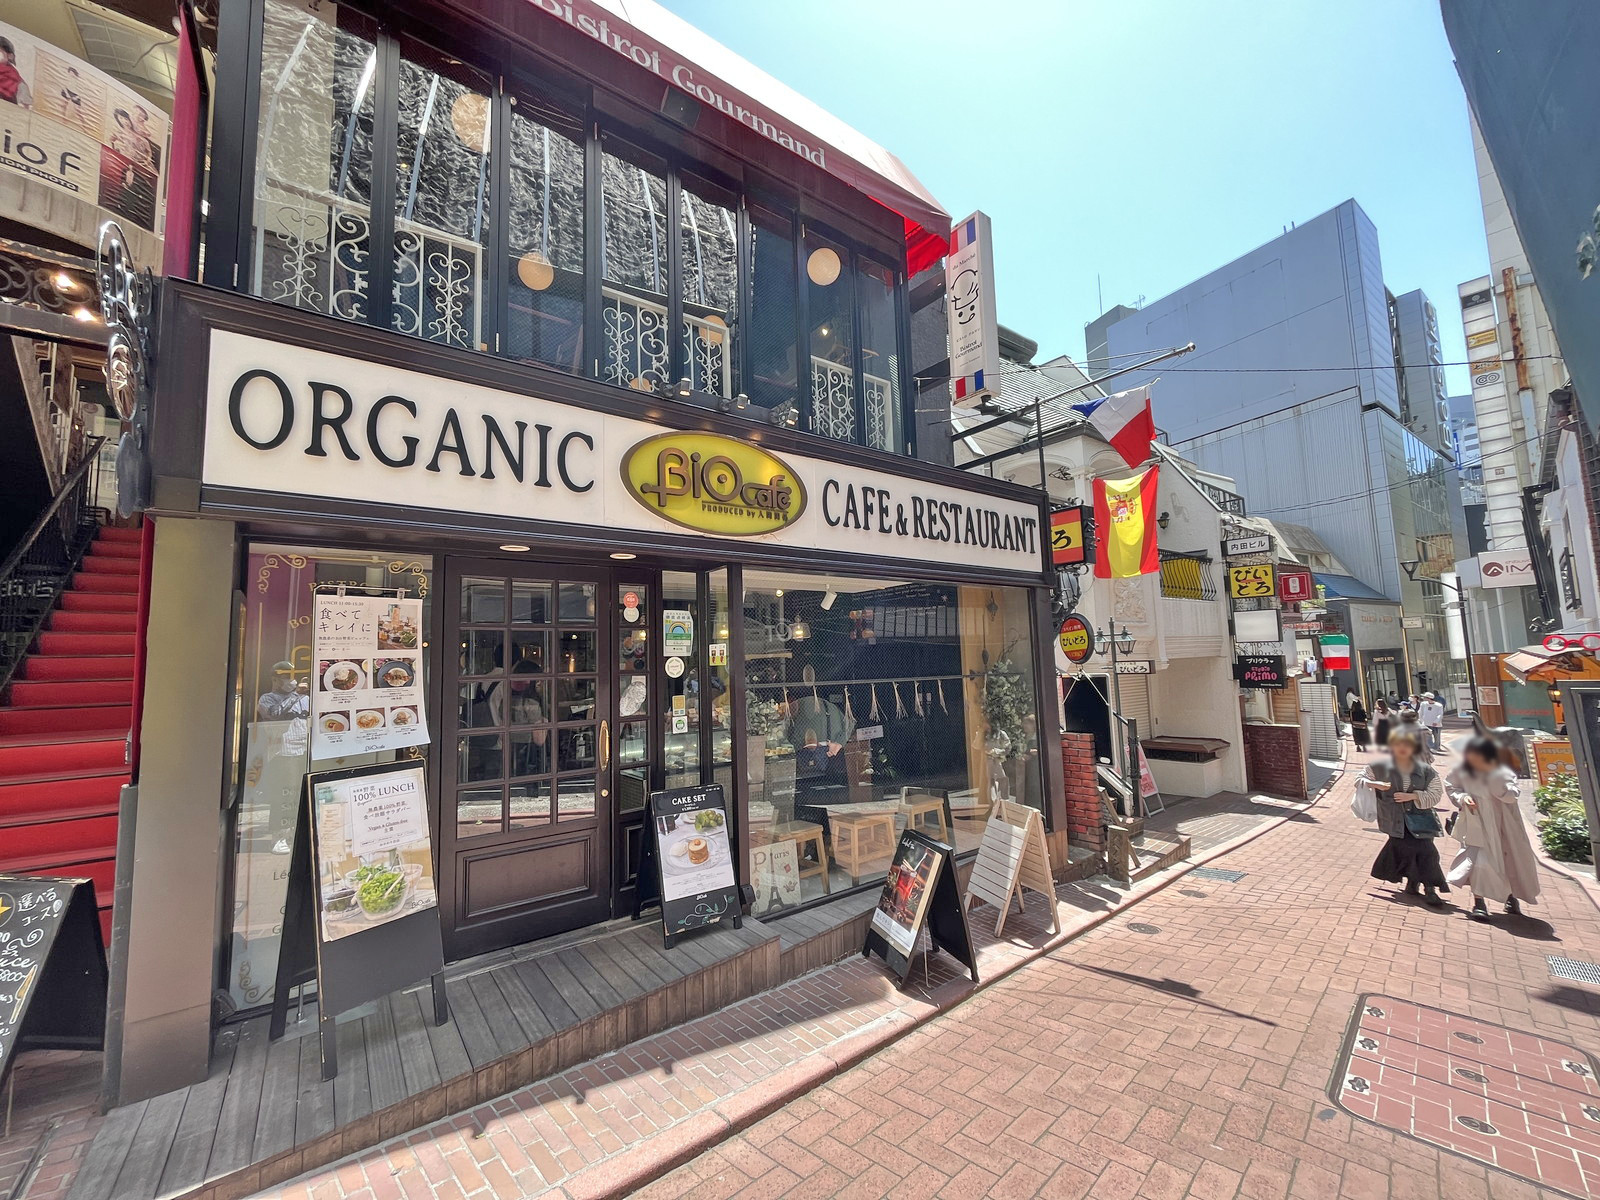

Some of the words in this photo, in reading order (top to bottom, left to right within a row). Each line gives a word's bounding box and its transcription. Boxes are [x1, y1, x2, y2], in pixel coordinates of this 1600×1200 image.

[672, 64, 827, 170] Gourmand
[227, 368, 595, 493] ORGANIC
[702, 503, 744, 516] PRODUCED
[746, 510, 756, 519] by
[822, 478, 893, 534] CAFE
[895, 502, 909, 536] &
[911, 495, 1037, 554] RESTAURANT
[1230, 540, 1266, 551] 内田ビル
[319, 607, 361, 620] 食べて
[318, 621, 372, 633] キレイに
[1061, 635, 1087, 647] びいどろ
[353, 791, 377, 803] 100%
[378, 782, 415, 797] LUNCH
[671, 796, 692, 806] CAKE
[692, 793, 707, 802] SET
[18, 887, 57, 913] 選べる
